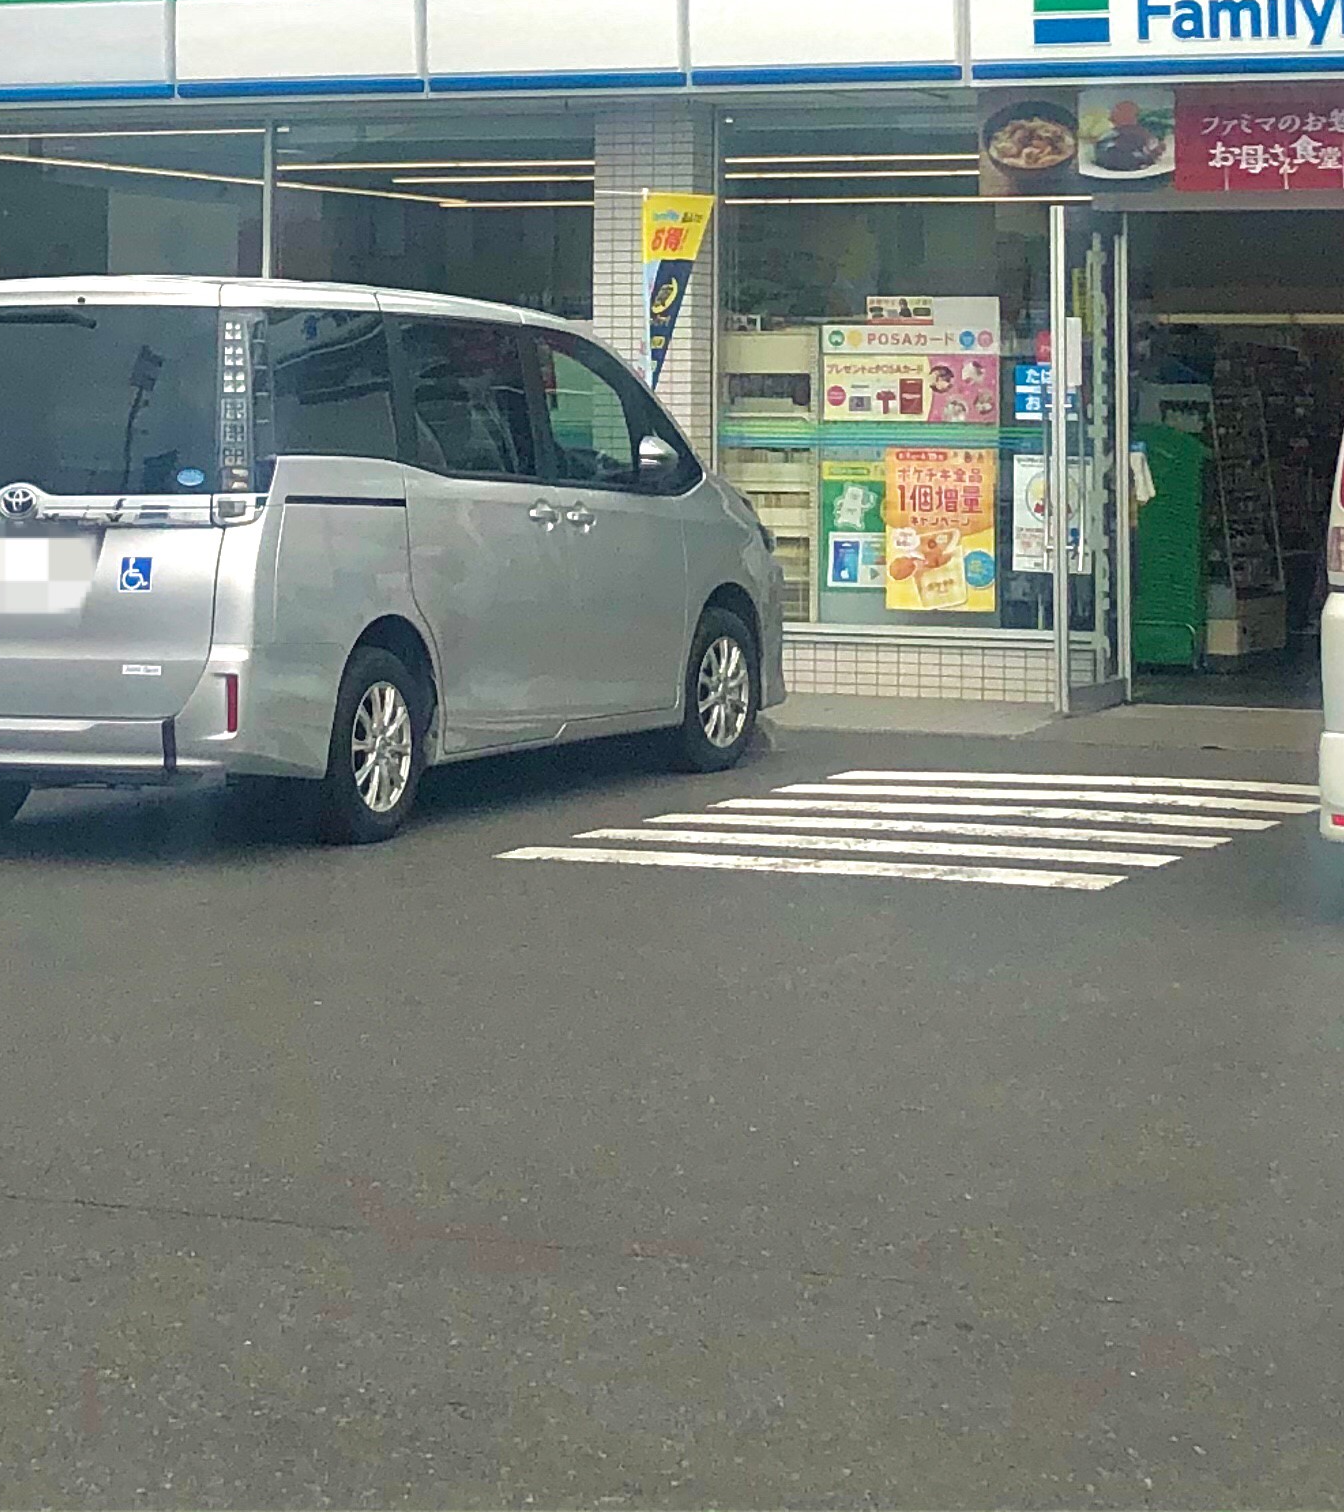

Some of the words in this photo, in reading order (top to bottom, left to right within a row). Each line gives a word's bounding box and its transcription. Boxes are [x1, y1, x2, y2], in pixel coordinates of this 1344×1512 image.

[1208, 134, 1343, 174] お母さん食堂
[866, 331, 956, 347] POSAカード
[897, 484, 983, 514] 1個増量
